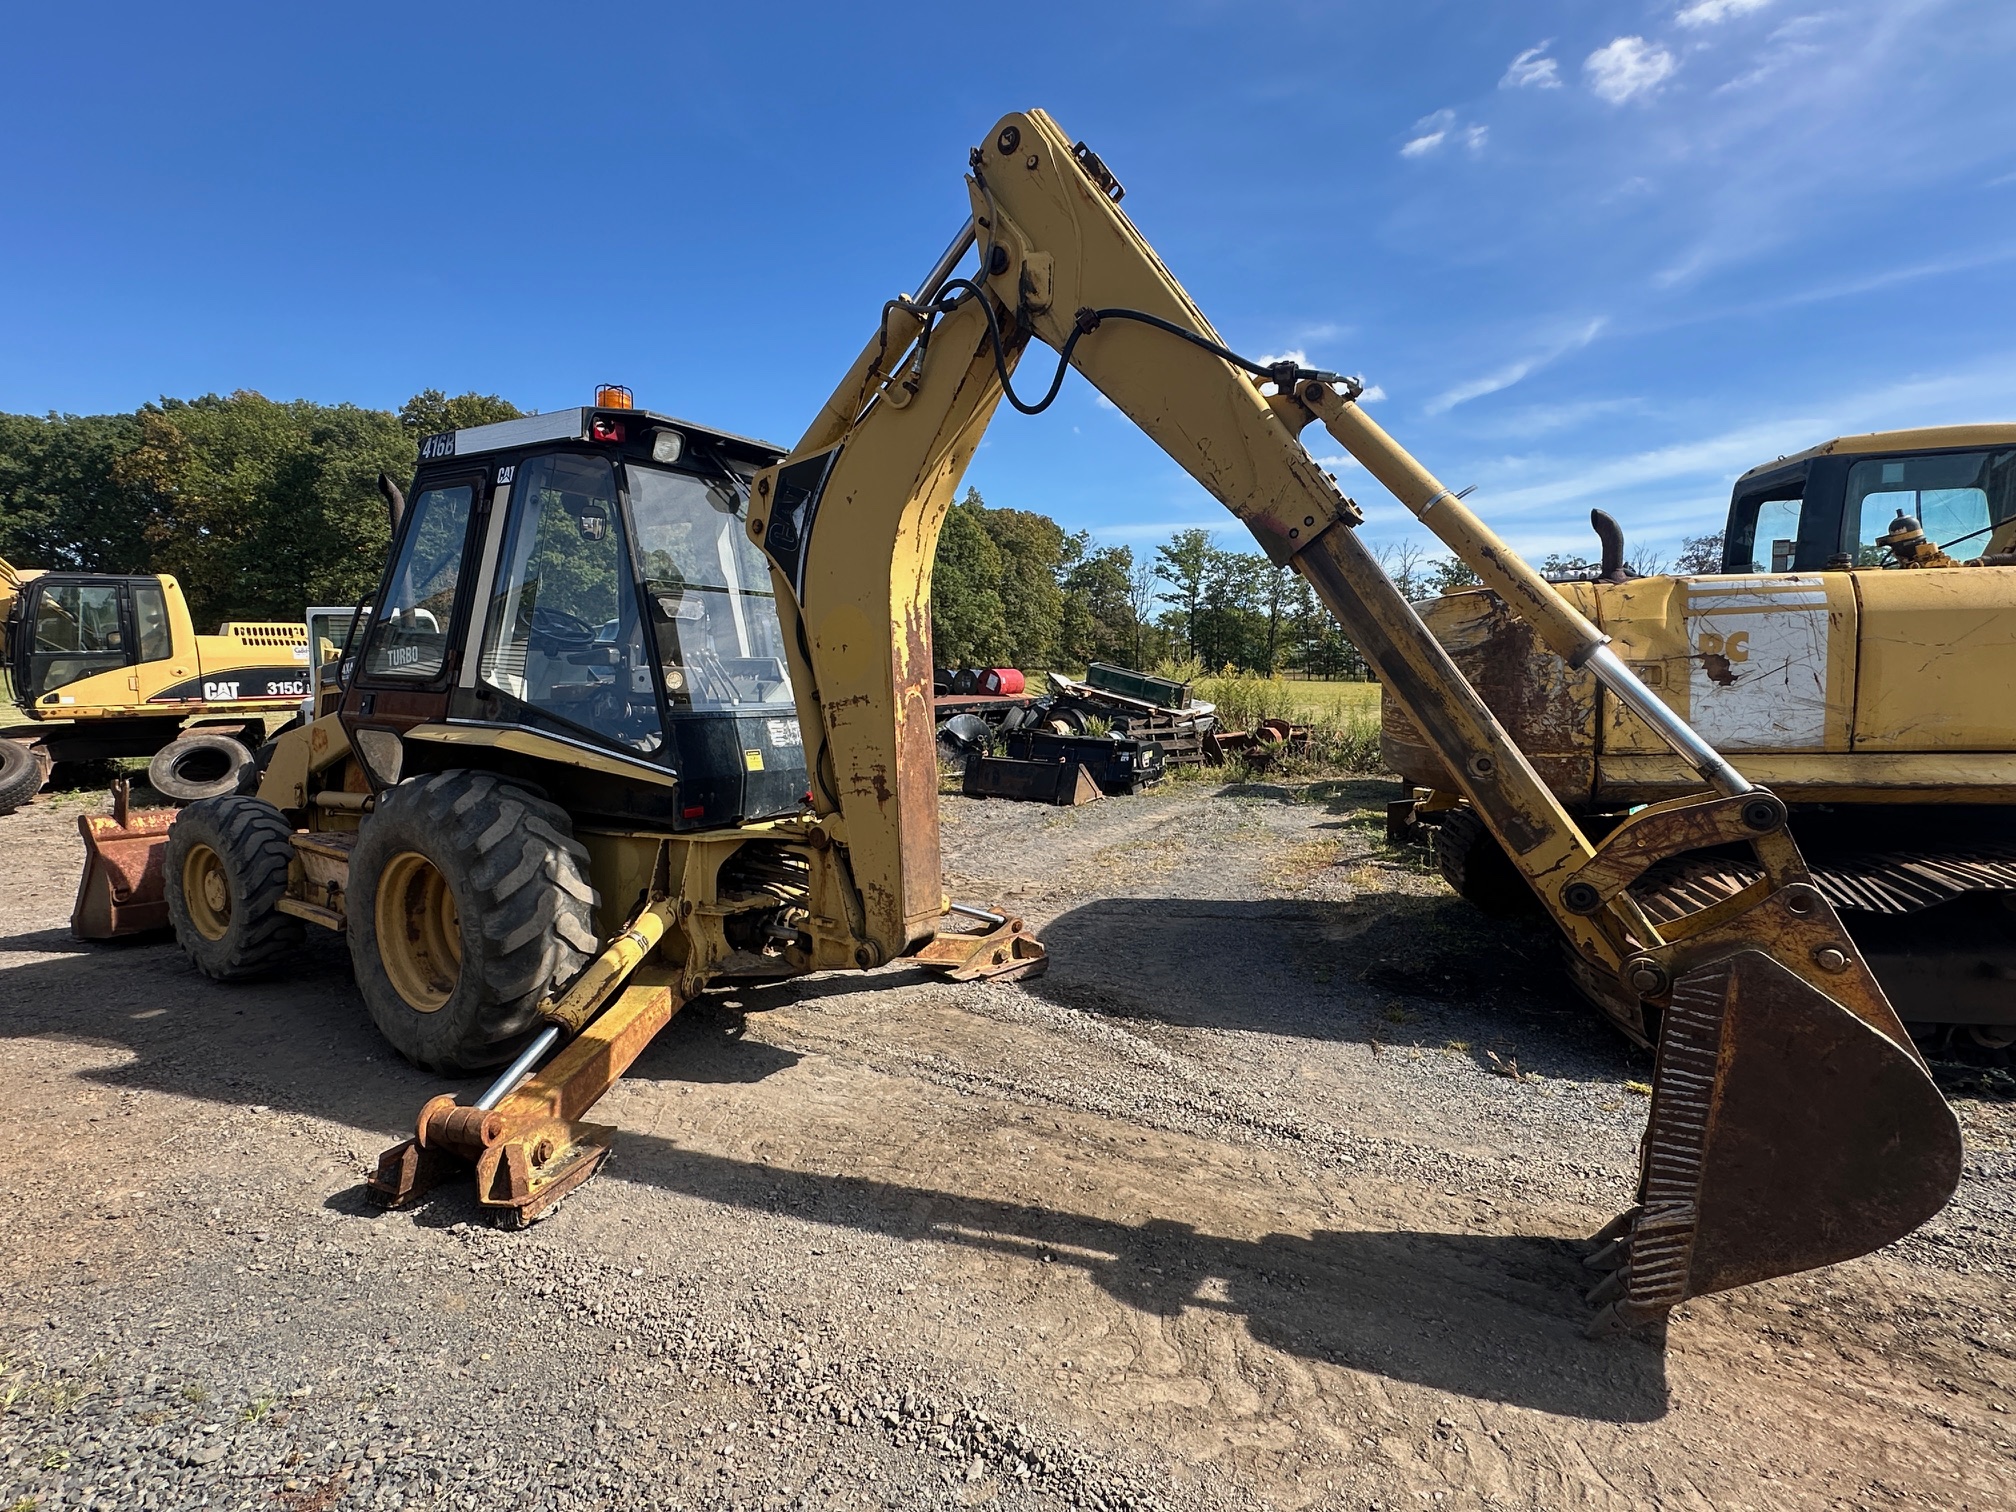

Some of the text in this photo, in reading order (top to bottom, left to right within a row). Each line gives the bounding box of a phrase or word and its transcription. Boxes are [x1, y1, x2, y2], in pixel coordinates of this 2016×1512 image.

[422, 434, 455, 458] 416B
[497, 466, 515, 483] CAT
[768, 476, 812, 552] CAT
[387, 646, 418, 666] TURBO
[1698, 631, 1748, 662] PC
[204, 682, 239, 700] CAT
[266, 681, 303, 694] 315C
